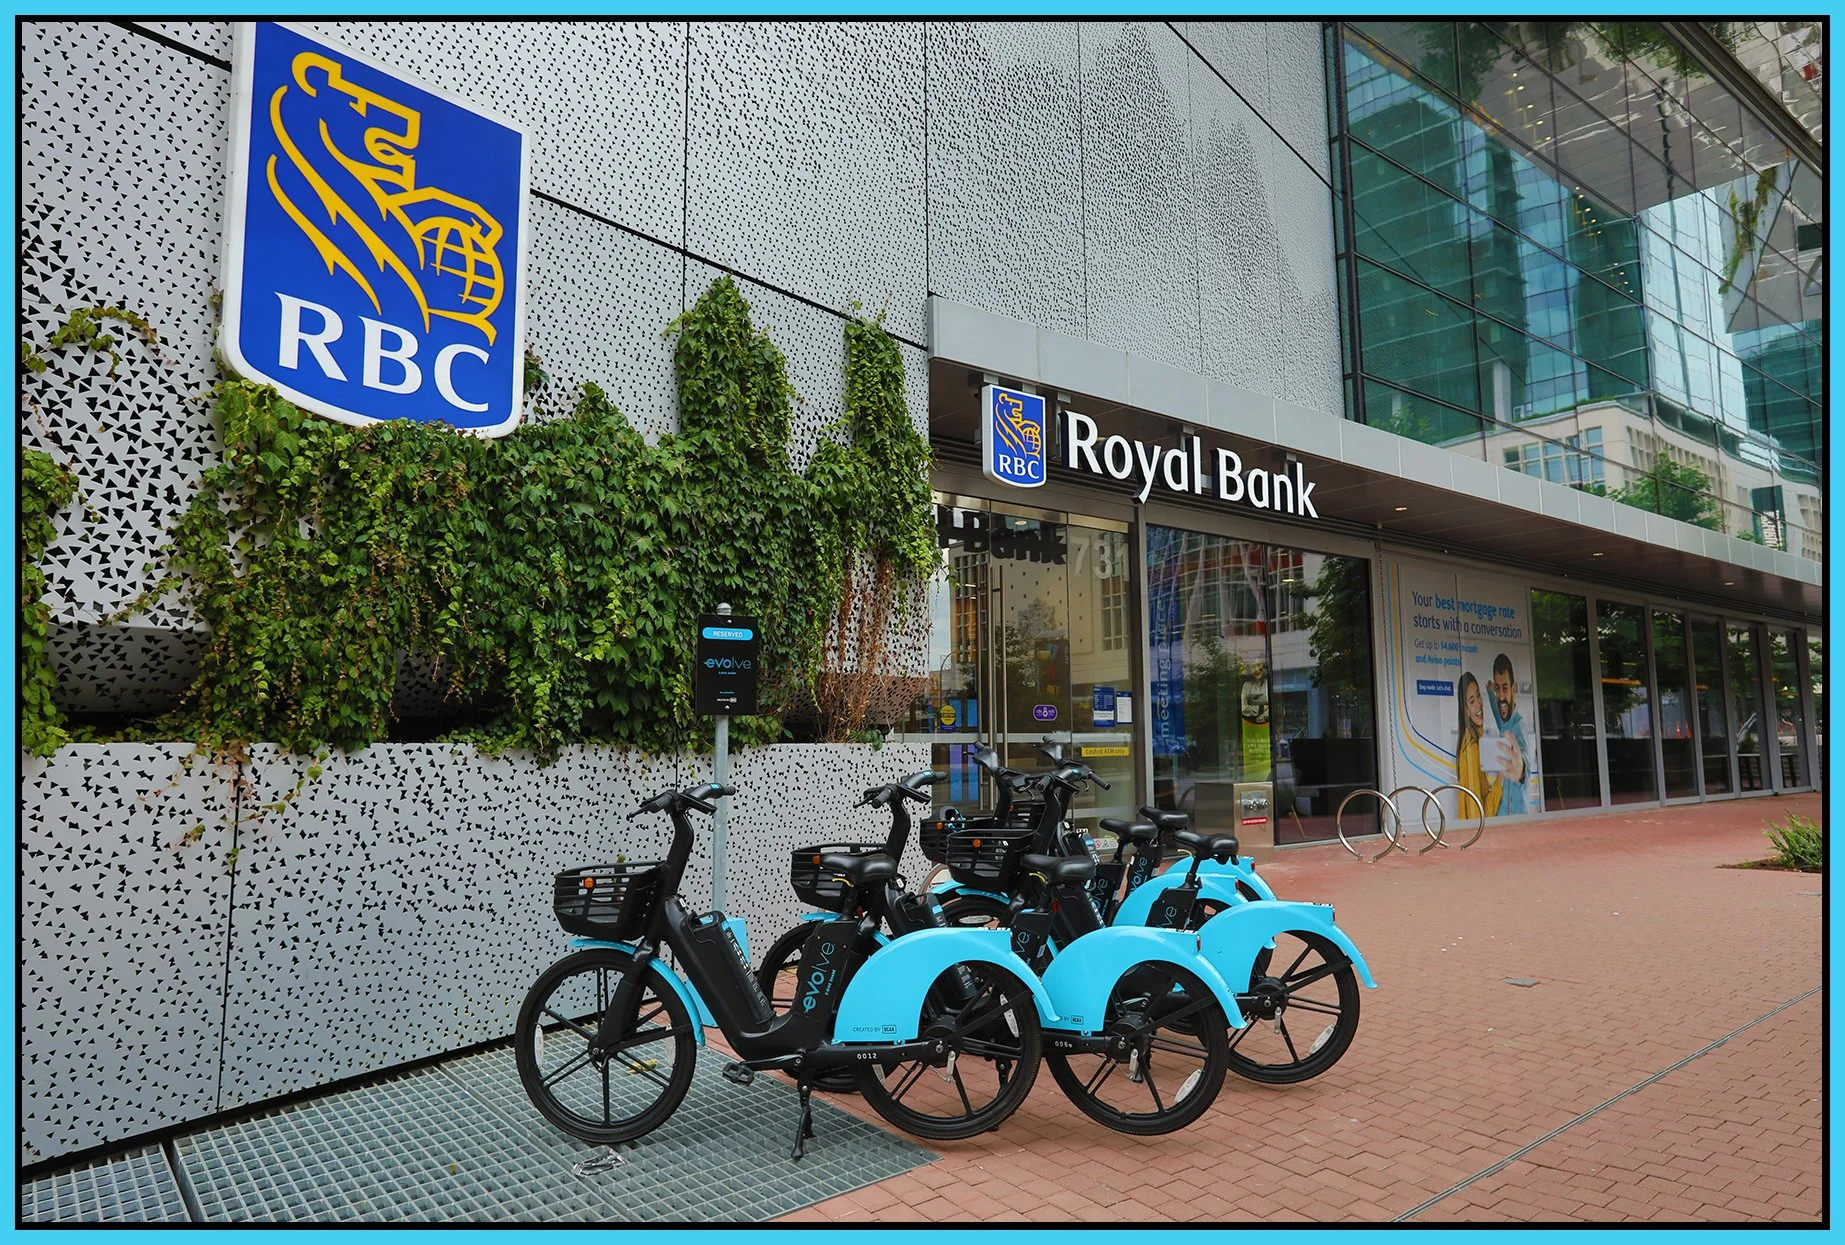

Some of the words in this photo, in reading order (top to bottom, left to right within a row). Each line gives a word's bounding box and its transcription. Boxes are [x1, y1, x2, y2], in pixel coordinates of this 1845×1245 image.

[274, 292, 490, 413] RBC
[999, 453, 1041, 479] RBC
[1064, 409, 1203, 504] Royal
[1216, 447, 1320, 519] Bank
[1070, 535, 1130, 582] 731
[1412, 590, 1433, 607] Your
[1435, 593, 1456, 611] best
[1458, 600, 1497, 621] mortgage
[1498, 606, 1516, 619] rate
[712, 630, 744, 638] RESERVED
[1413, 615, 1440, 629] starts
[1443, 617, 1462, 633] with
[1464, 622, 1469, 633] a
[1471, 622, 1522, 638] conversation
[704, 656, 751, 670] evolve
[1415, 639, 1425, 649] Get
[1425, 641, 1435, 653] up
[1434, 641, 1440, 650] to
[1157, 659, 1171, 738] meeting
[1129, 857, 1148, 894] volve
[803, 942, 836, 1013] evolve
